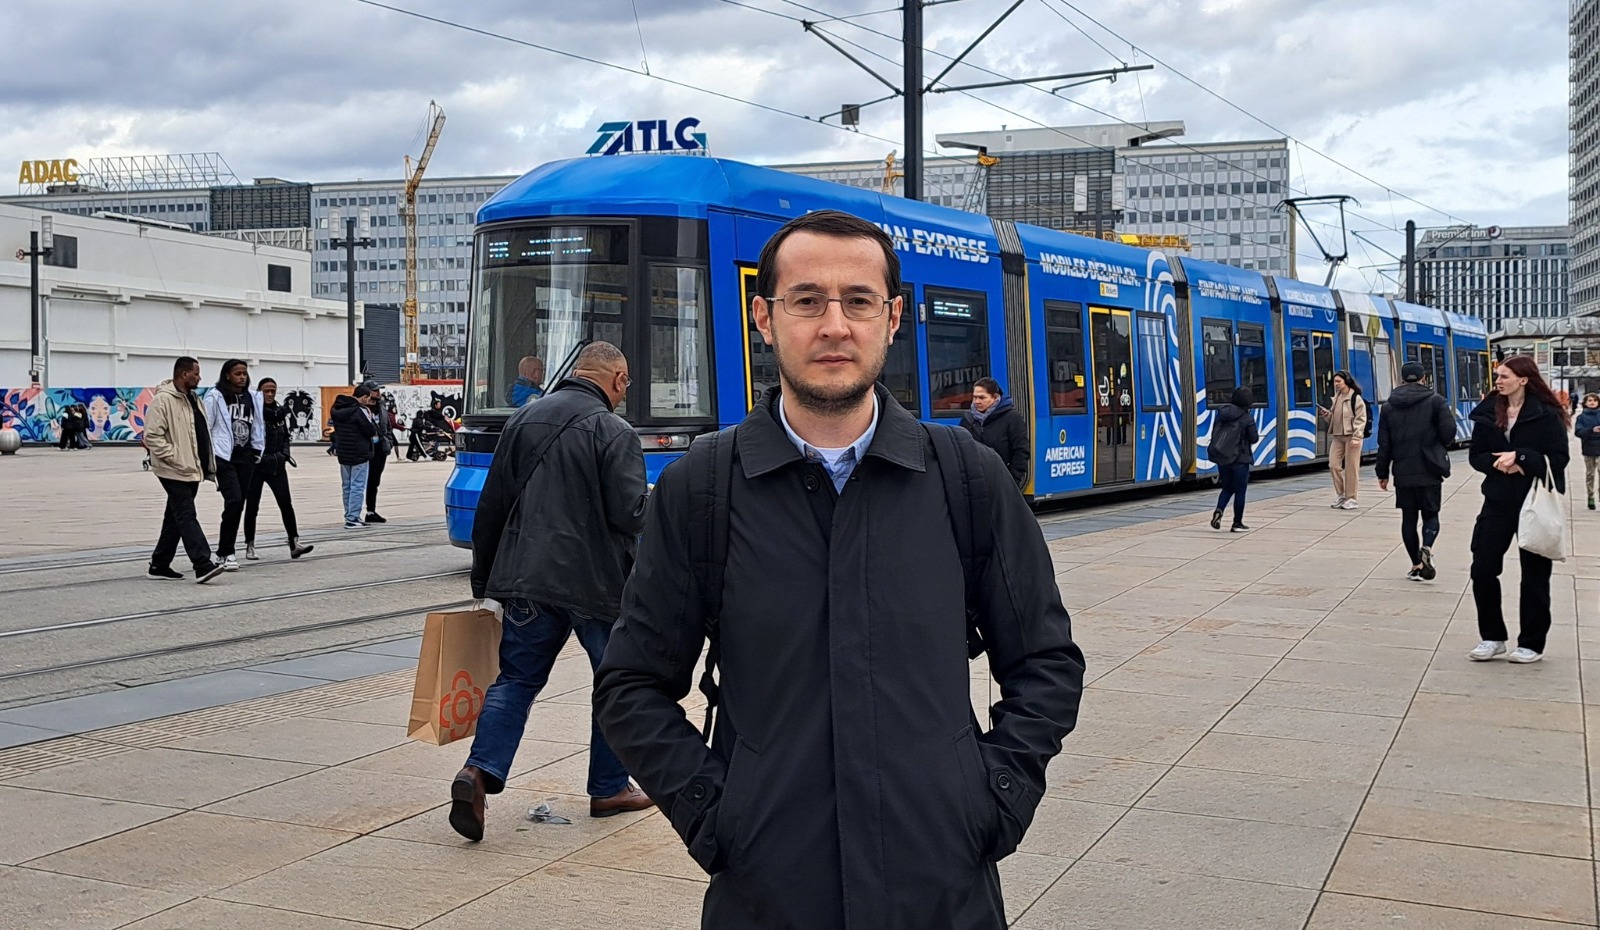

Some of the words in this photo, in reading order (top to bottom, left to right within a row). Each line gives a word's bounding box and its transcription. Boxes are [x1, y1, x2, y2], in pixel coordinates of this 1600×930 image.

[637, 117, 706, 151] TLG
[19, 158, 78, 183] ADAC
[912, 228, 990, 264] EXPRESS
[1431, 229, 1470, 239] Premier
[1471, 230, 1486, 238] Inn
[1040, 252, 1088, 279] MOBILES
[1044, 445, 1086, 462] AMERICAN
[1050, 460, 1086, 478] EXPRESS
